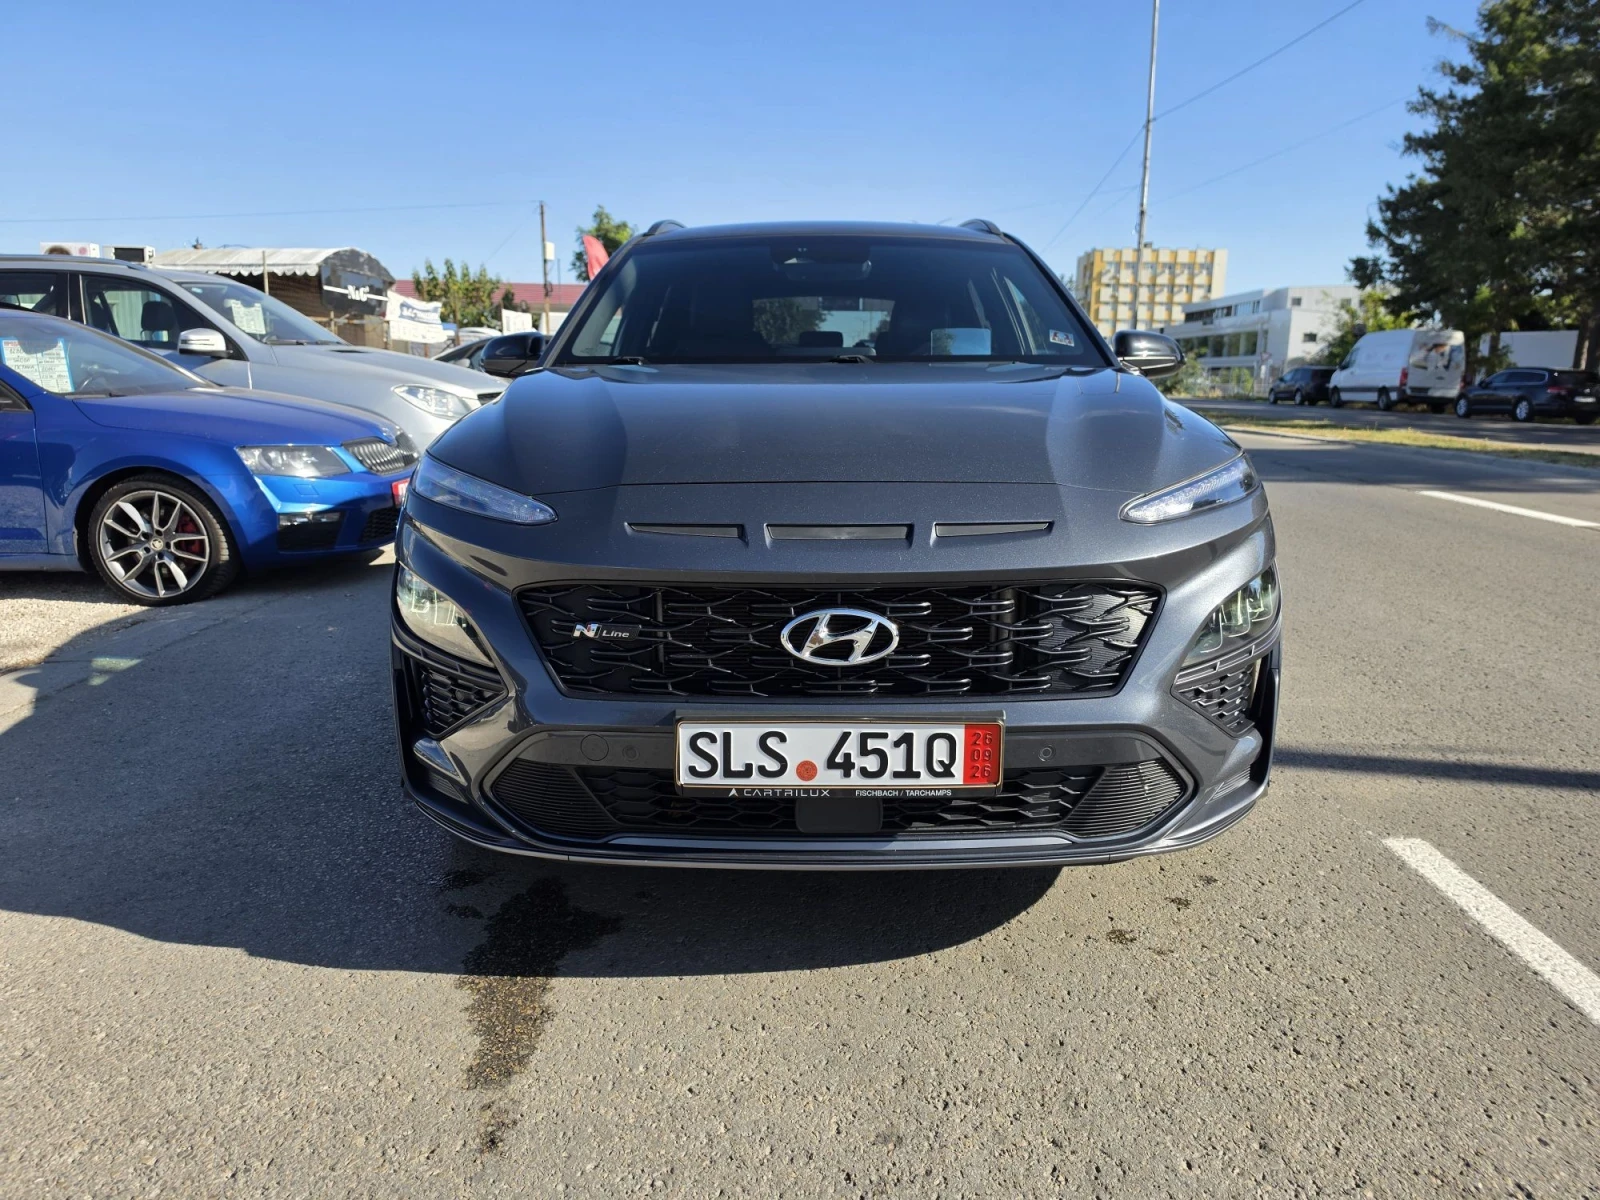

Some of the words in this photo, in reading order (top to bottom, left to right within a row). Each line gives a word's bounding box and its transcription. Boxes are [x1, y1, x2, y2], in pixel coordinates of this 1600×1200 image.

[573, 623, 602, 638] N
[602, 630, 630, 638] Line
[971, 731, 993, 746] 26
[688, 731, 788, 778] SLS
[826, 731, 957, 778] 451Q
[971, 748, 993, 762] 09
[970, 764, 992, 778] 26
[743, 788, 830, 797] CARTRILUX
[855, 789, 899, 797] FISCHBACH
[905, 789, 952, 797] TARCHAMPS
